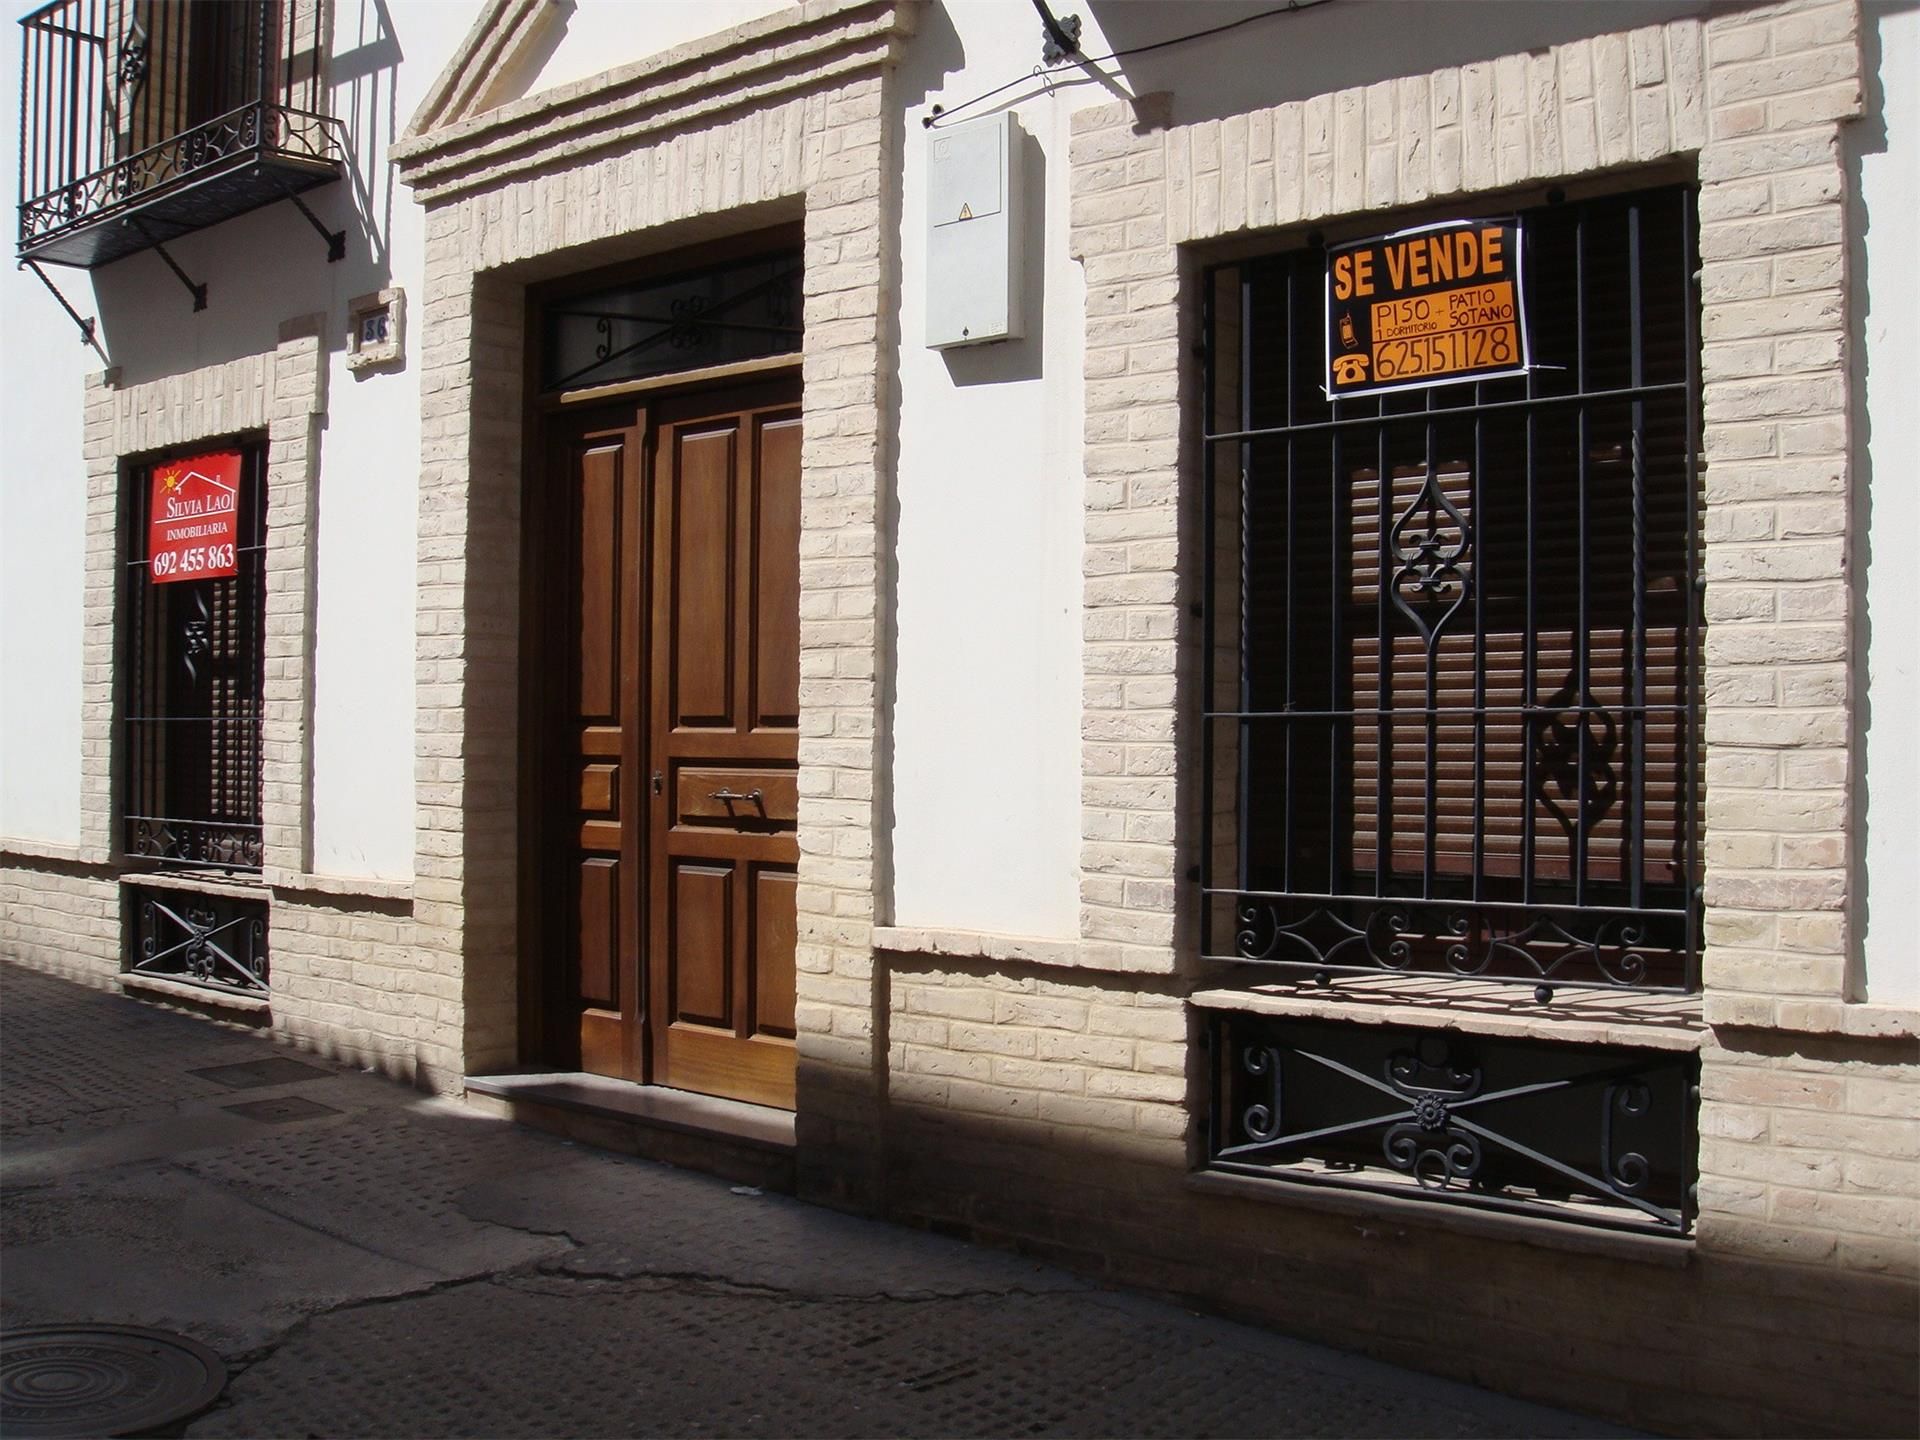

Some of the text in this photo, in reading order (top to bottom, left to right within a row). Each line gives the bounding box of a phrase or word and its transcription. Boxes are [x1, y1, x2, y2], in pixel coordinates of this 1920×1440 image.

[1334, 227, 1503, 300] SE VENDE
[1376, 299, 1430, 327] PISO
[1448, 289, 1495, 310] PATIO
[1449, 304, 1512, 328] SOTANO
[1375, 322, 1438, 341] 1 DORMITORIO
[206, 494, 231, 512] LAO
[167, 522, 228, 541] INMOBILIARIA
[154, 543, 234, 576] 692 455 863
